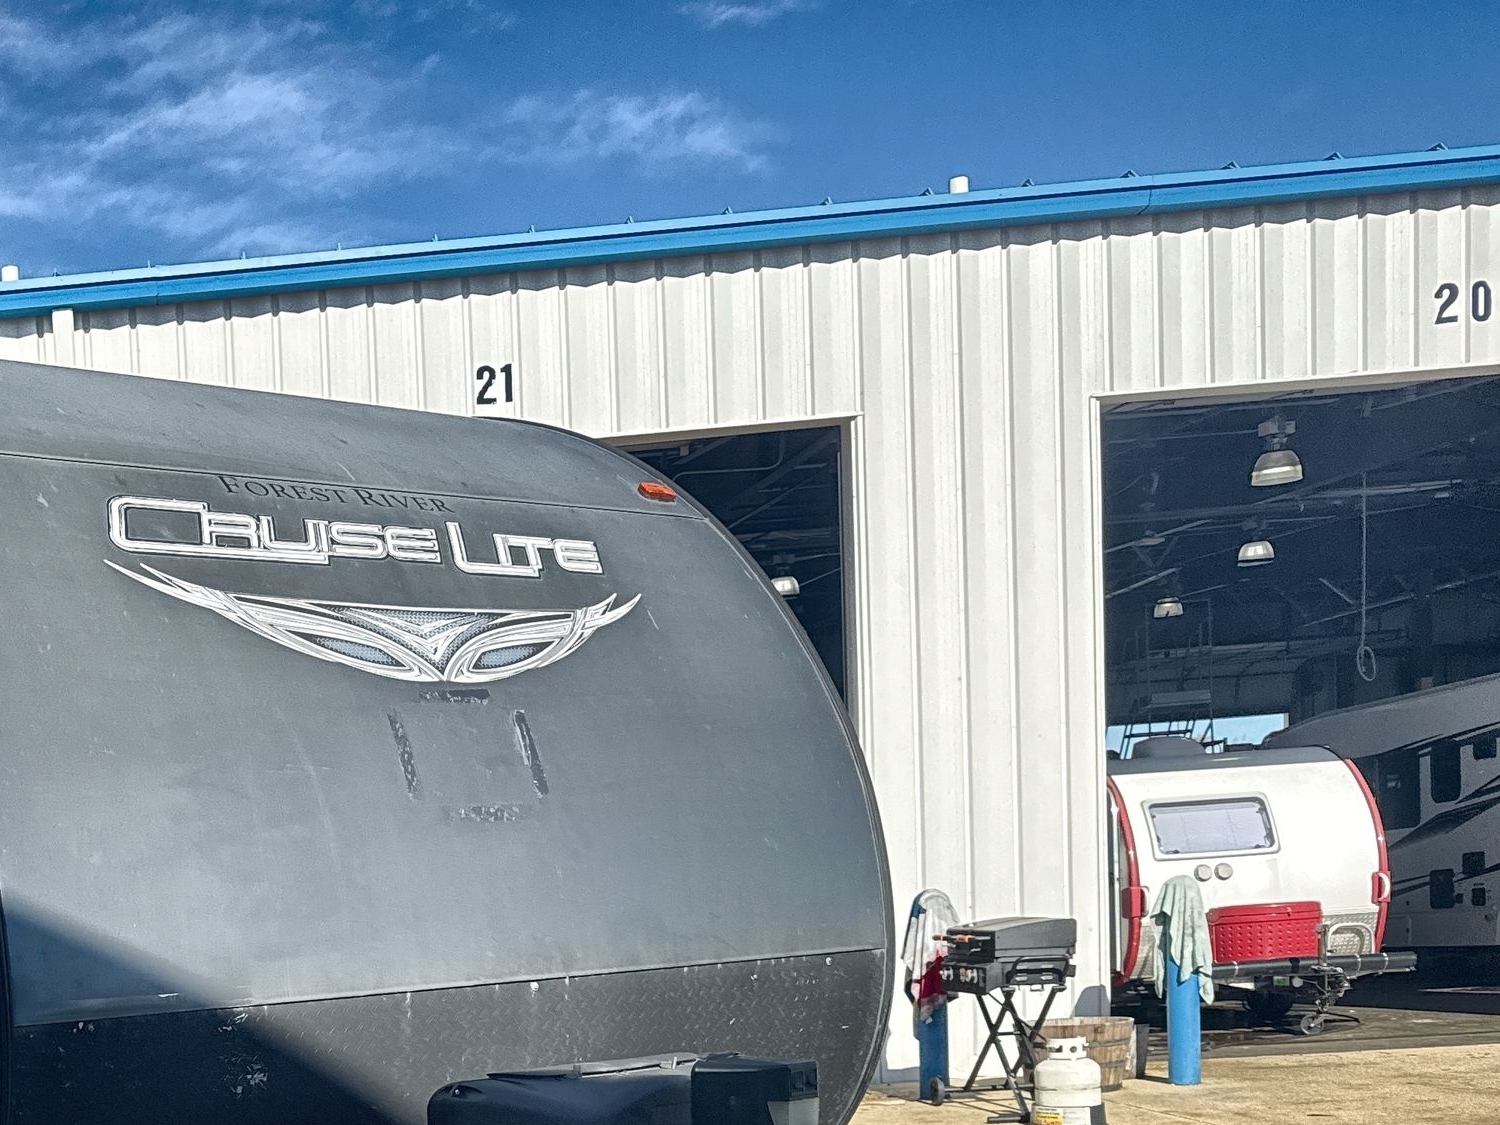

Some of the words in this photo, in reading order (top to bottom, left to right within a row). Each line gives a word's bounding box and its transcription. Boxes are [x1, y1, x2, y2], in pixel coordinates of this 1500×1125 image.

[1434, 280, 1492, 325] 20
[476, 363, 513, 405] 21
[218, 475, 346, 504] FOREST
[353, 488, 455, 513] RIVER
